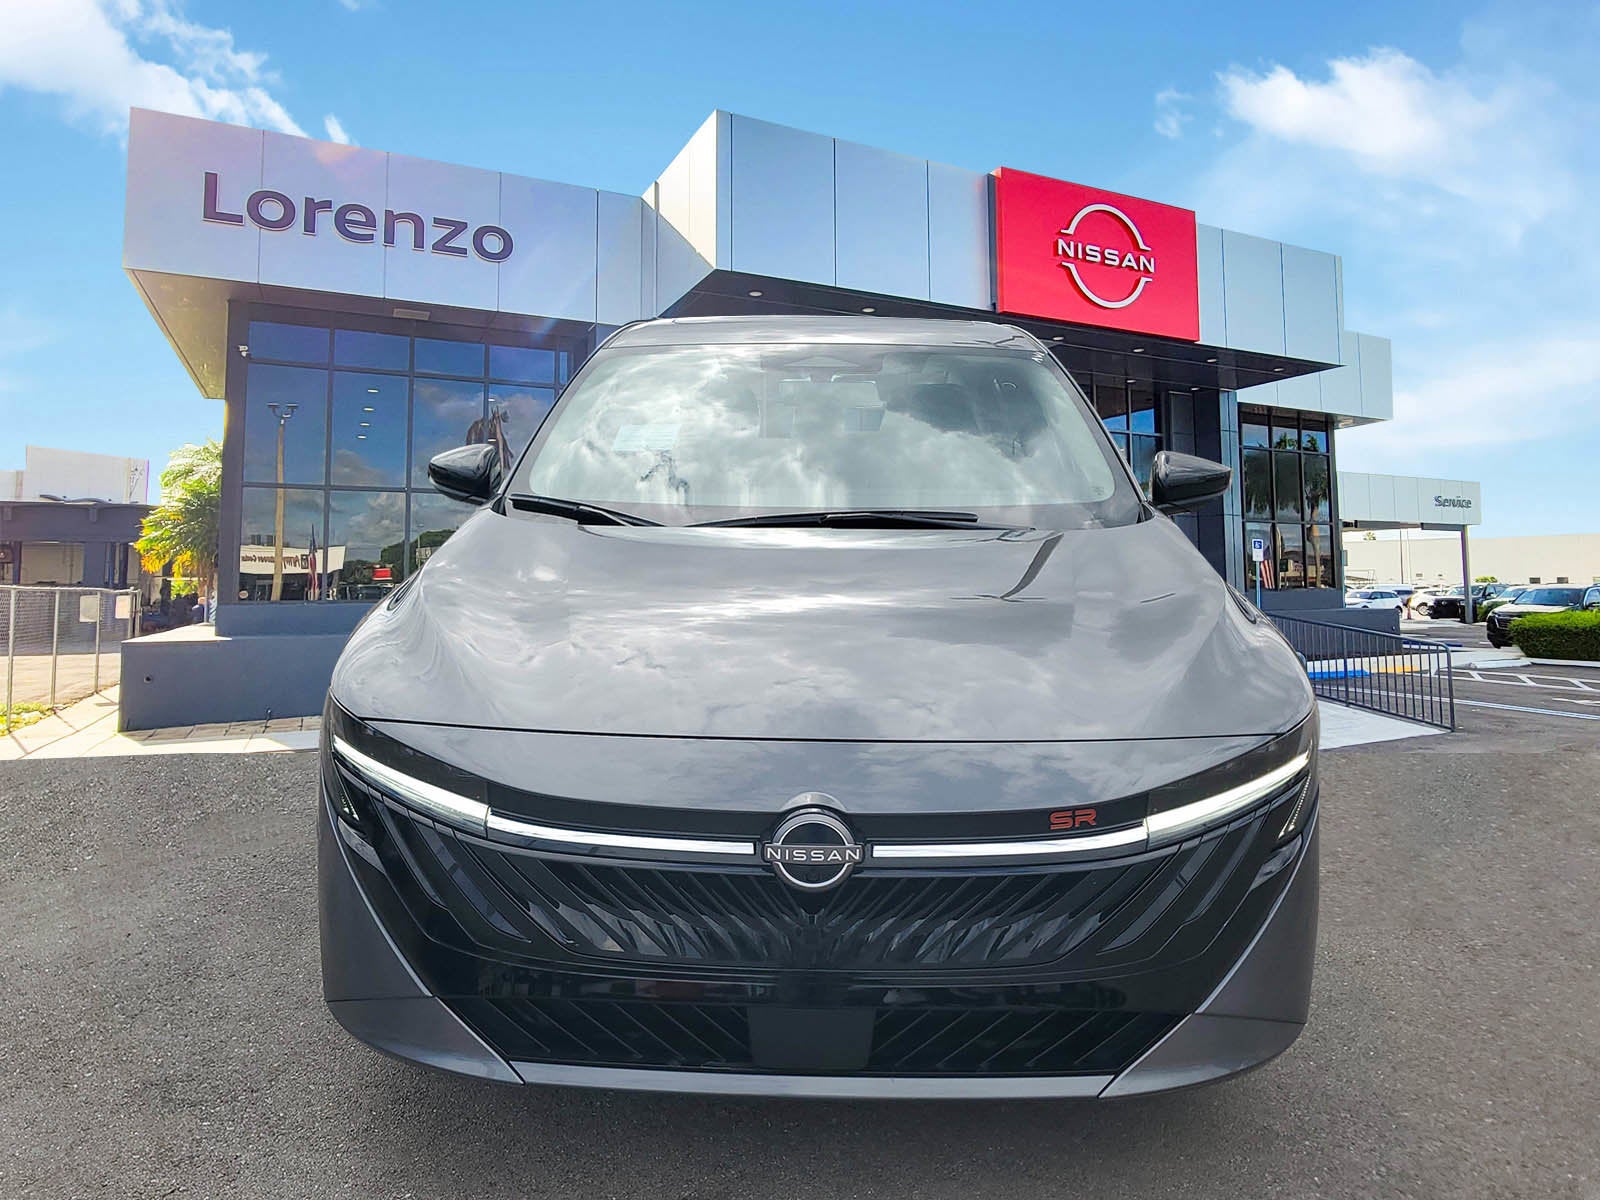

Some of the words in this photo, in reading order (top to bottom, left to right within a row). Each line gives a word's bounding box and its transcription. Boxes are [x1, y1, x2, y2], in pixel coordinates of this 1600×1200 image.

[202, 171, 514, 262] Lorenzo
[1057, 238, 1155, 273] NISSAN
[1434, 495, 1472, 509] Service
[1050, 808, 1097, 830] SR
[767, 847, 860, 861] NISSAN
